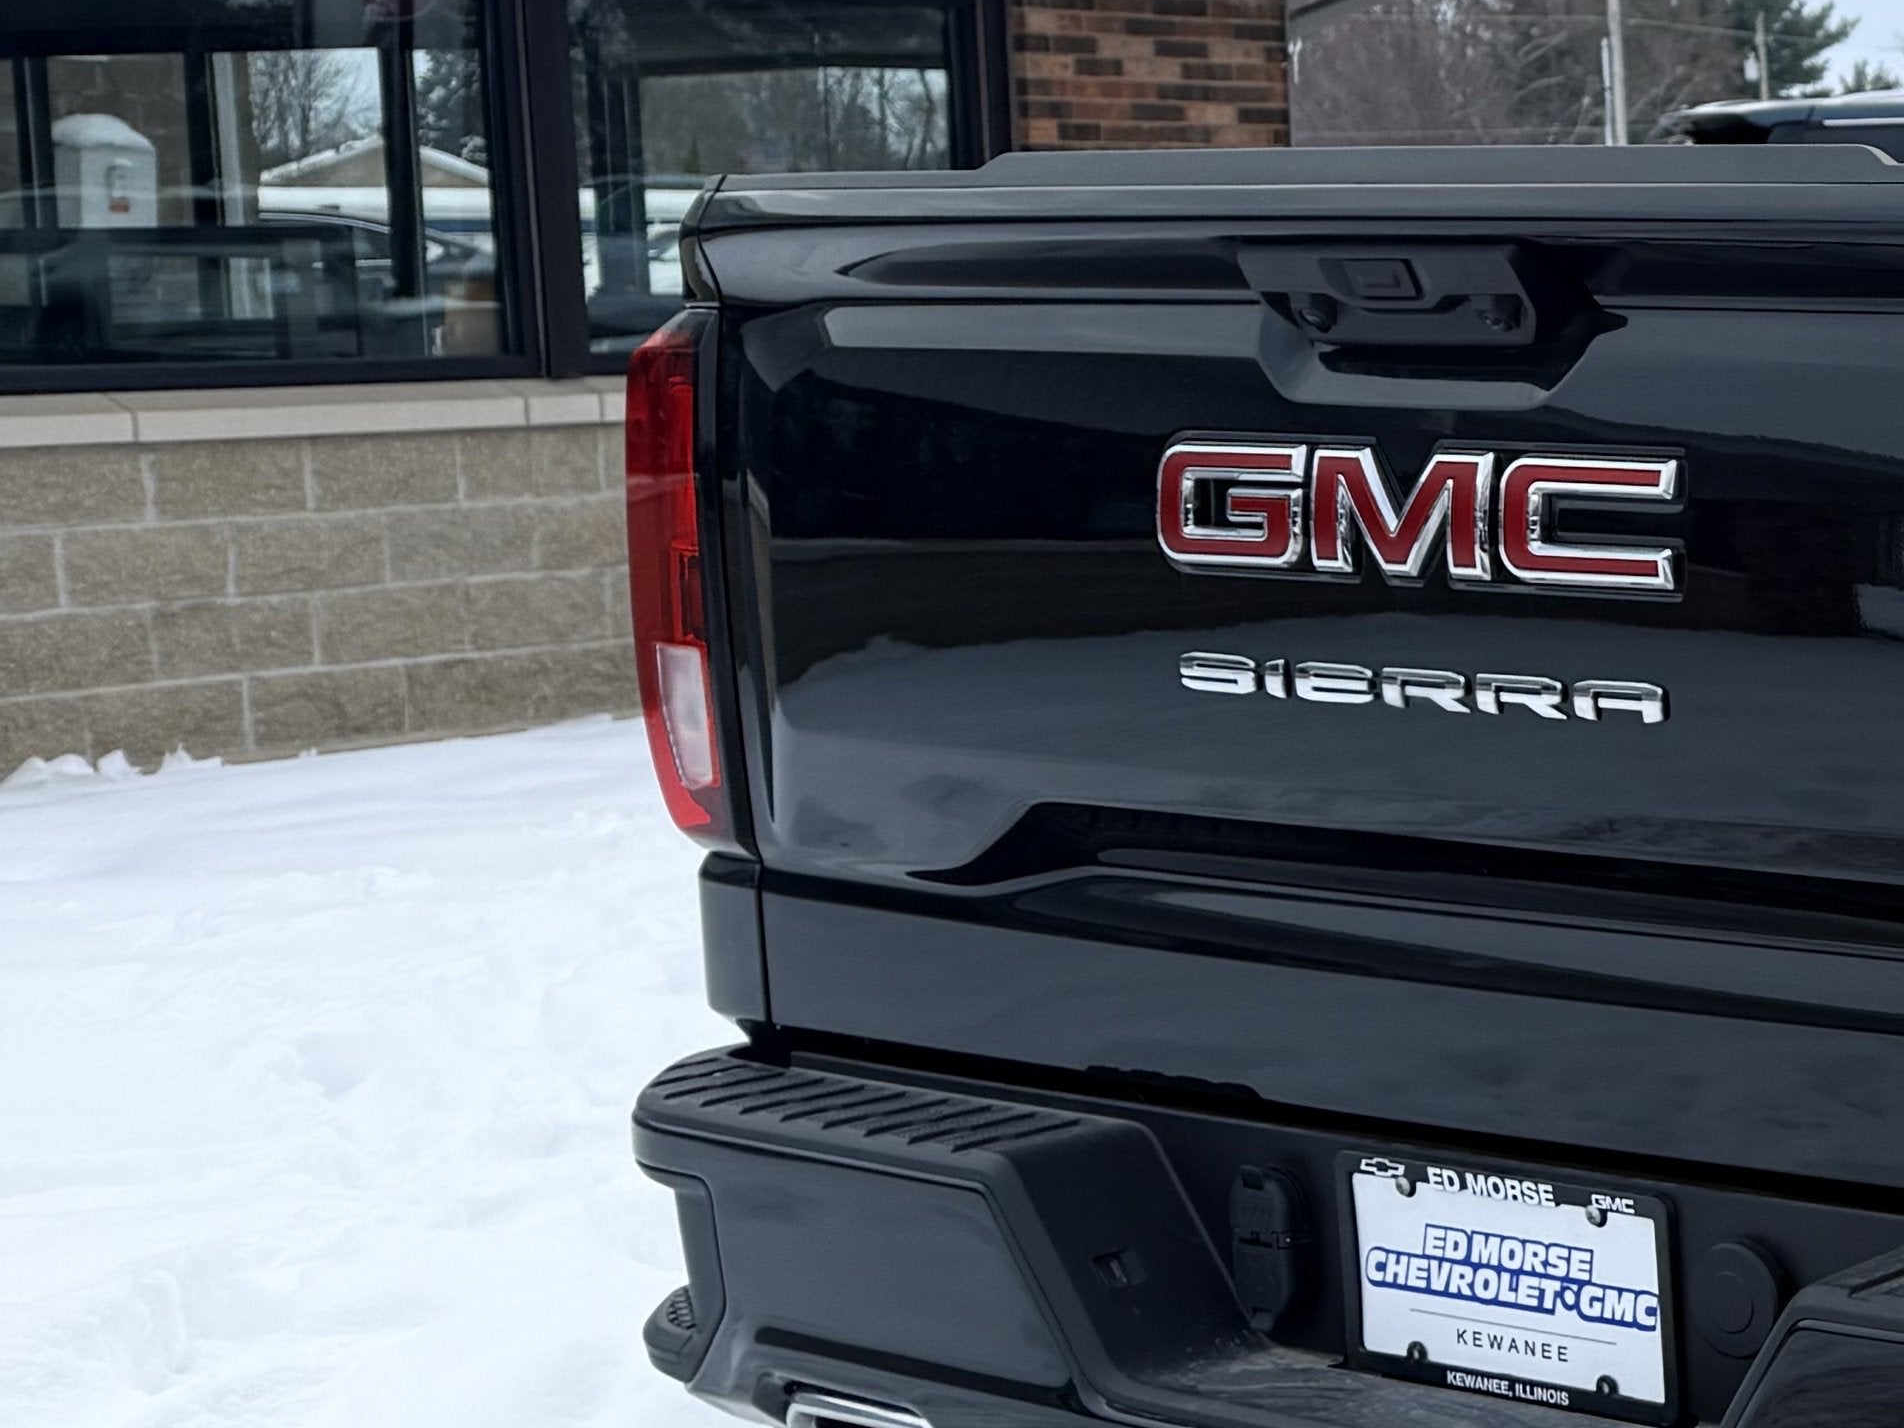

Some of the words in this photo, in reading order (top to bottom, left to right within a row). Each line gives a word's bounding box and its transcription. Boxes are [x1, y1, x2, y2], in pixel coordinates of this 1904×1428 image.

[1155, 439, 1681, 592] GMC
[1179, 651, 1670, 724] SIERRA
[1426, 1166, 1460, 1193] ED
[1465, 1172, 1556, 1207] MORSE
[1591, 1194, 1635, 1214] GMC
[1425, 1226, 1468, 1261] ED
[1470, 1233, 1593, 1280] MORSE
[1456, 1328, 1569, 1362] KEWANEE
[1446, 1371, 1512, 1397] KEWANEE,
[1515, 1384, 1569, 1405] ILLINOIS
